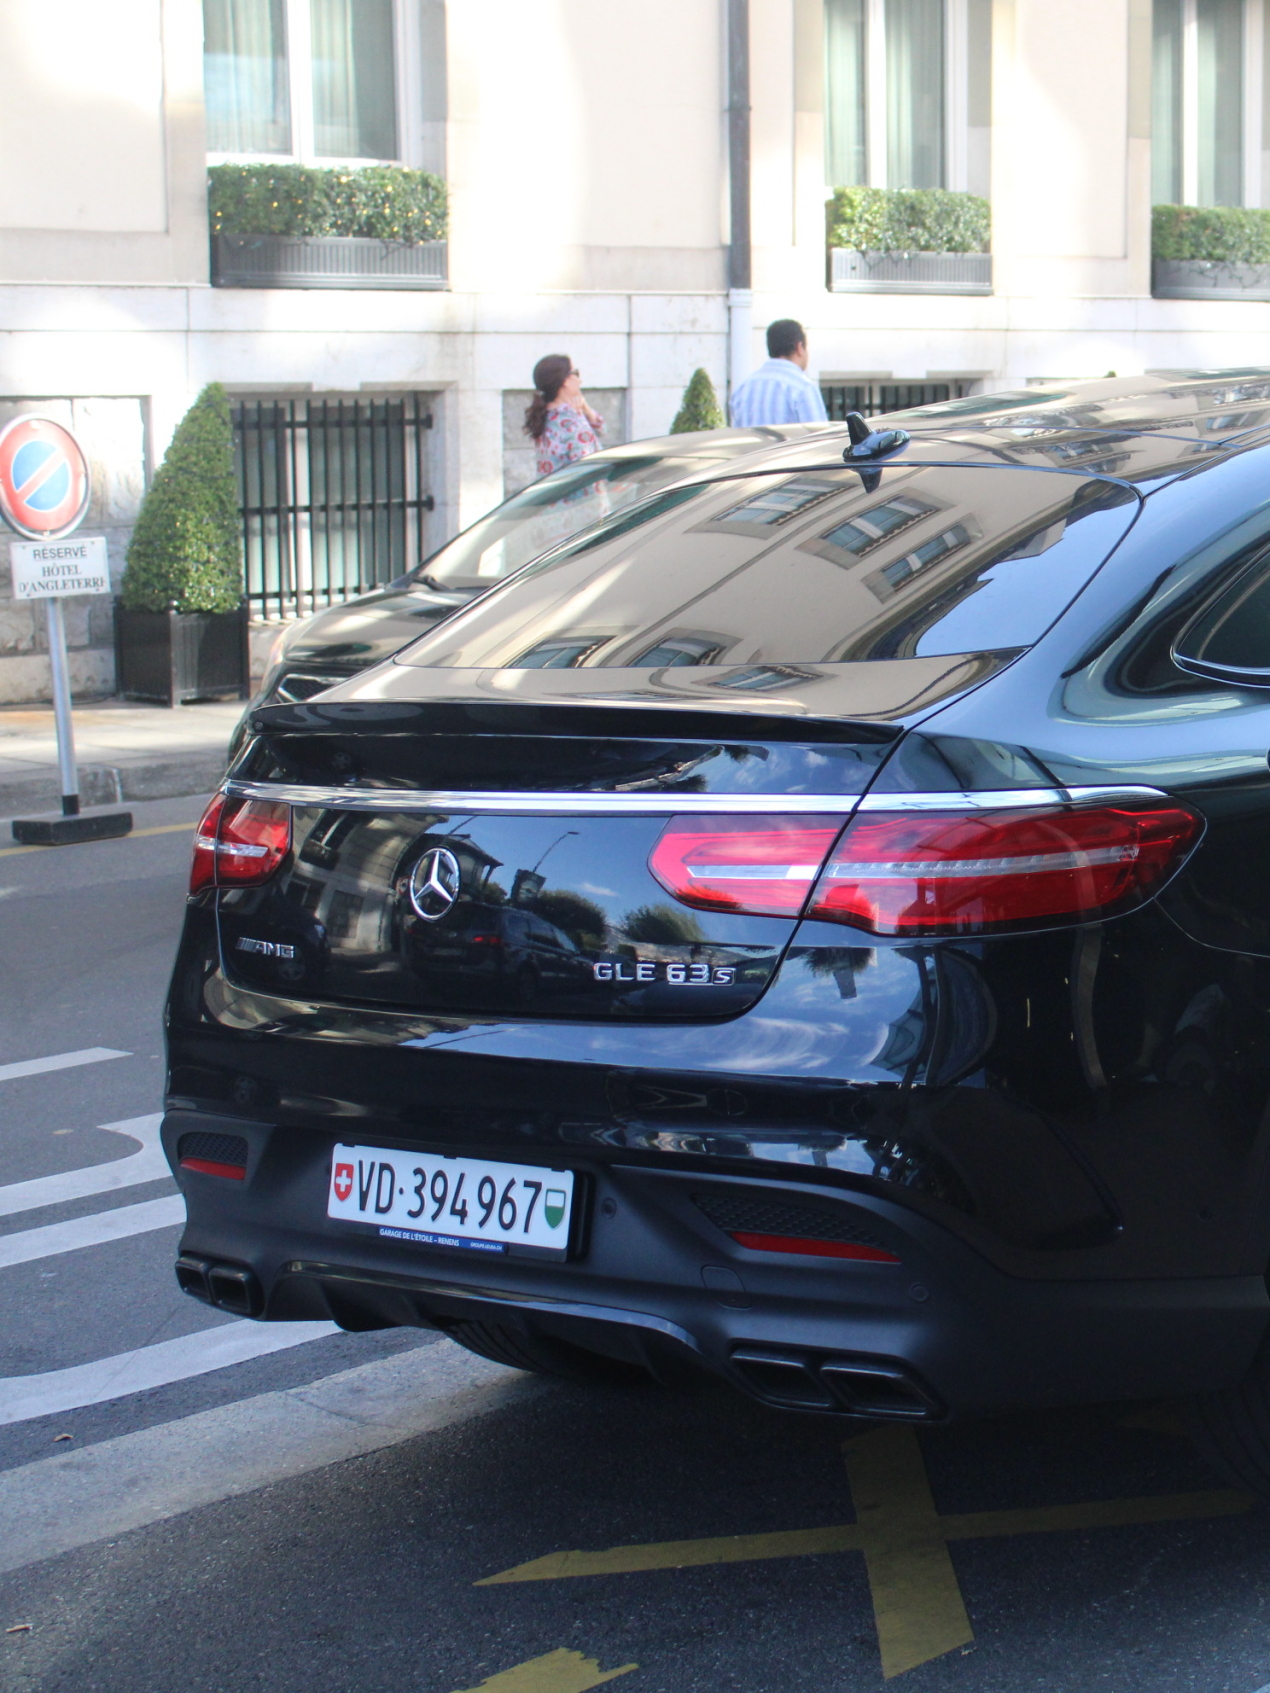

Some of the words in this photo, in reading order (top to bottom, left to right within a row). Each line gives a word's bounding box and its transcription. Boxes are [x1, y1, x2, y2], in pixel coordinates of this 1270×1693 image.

[42, 563, 81, 577] HÔTEL
[255, 940, 294, 959] AMG
[594, 962, 656, 981] GLE
[379, 1228, 402, 1239] GARAGE
[402, 1232, 410, 1240] DE
[438, 1237, 460, 1246] RENENS
